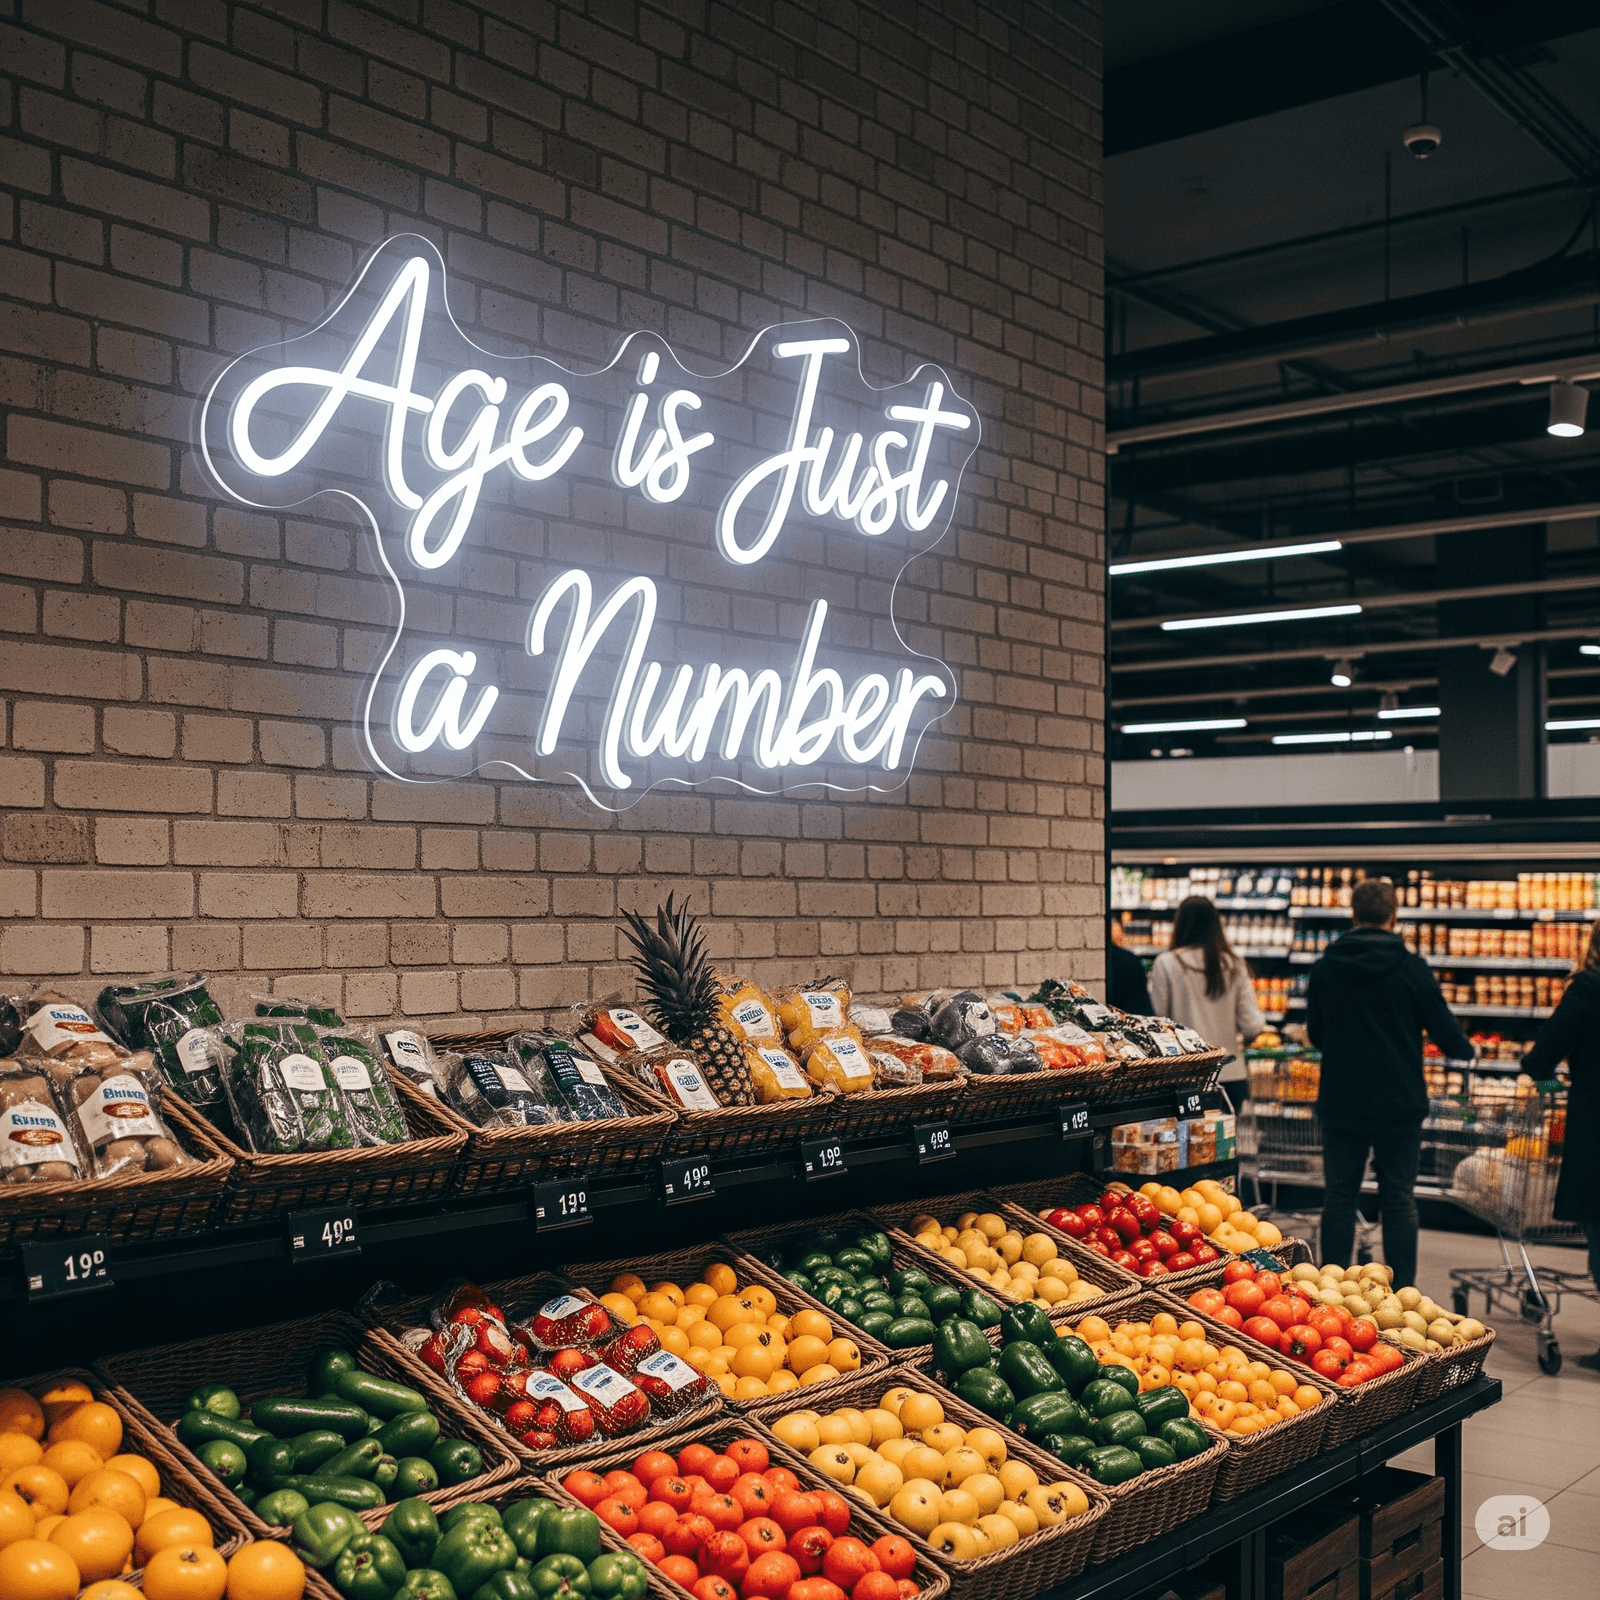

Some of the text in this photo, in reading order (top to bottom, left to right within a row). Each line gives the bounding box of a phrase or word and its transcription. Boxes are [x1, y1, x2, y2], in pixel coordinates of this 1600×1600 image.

[231, 256, 971, 569] Age is Just
[395, 569, 947, 790] a Number
